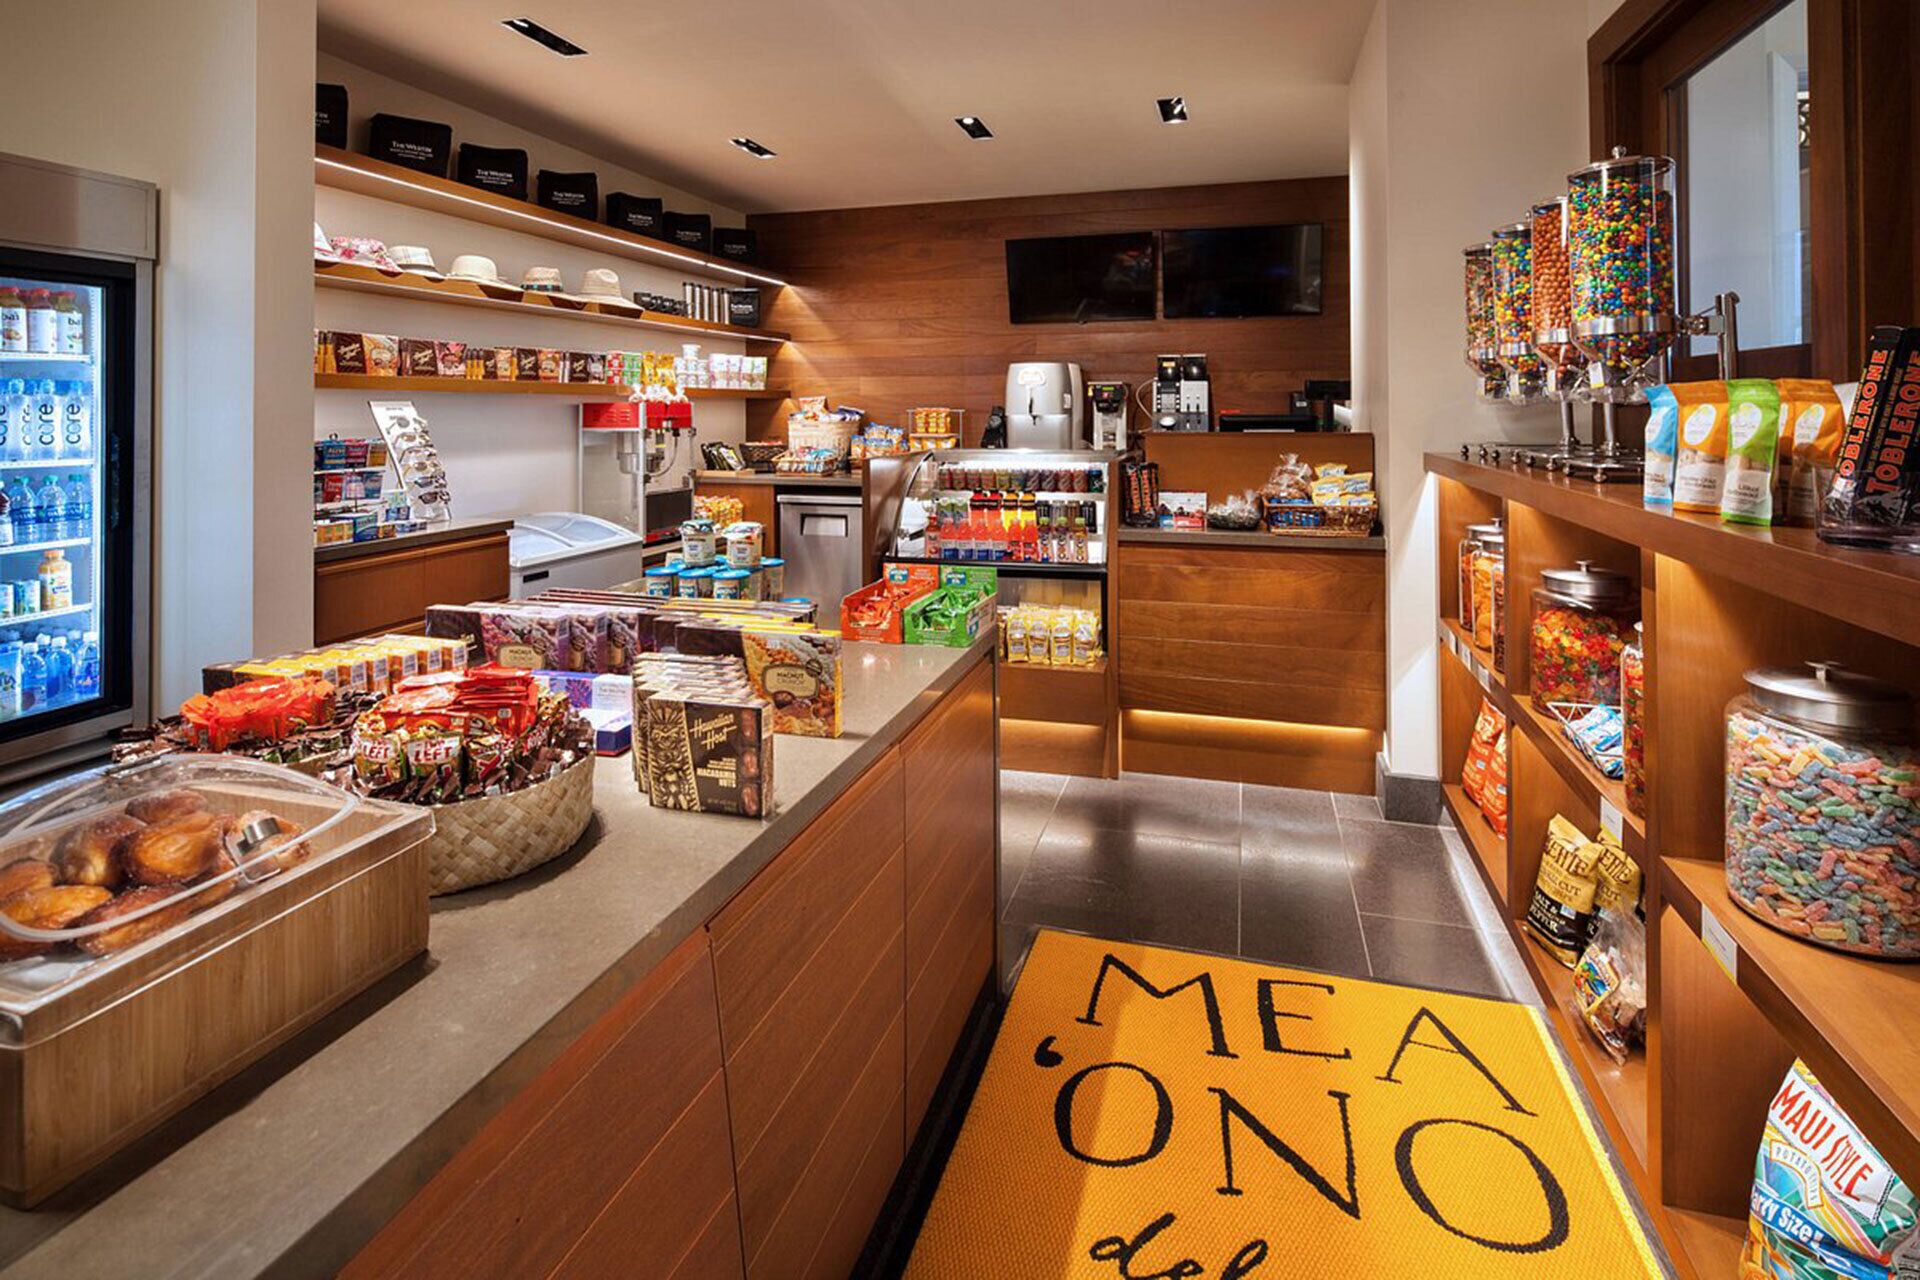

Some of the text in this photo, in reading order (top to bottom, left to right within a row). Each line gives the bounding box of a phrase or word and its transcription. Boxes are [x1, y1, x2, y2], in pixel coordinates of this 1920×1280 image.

[38, 403, 55, 446] core
[65, 403, 82, 445] core
[362, 744, 390, 760] LEFT
[414, 746, 453, 762] LEFT
[1598, 846, 1633, 886] ETTLE
[1075, 953, 1539, 1118] MEA
[1770, 1079, 1874, 1202] MAUI STYLE
